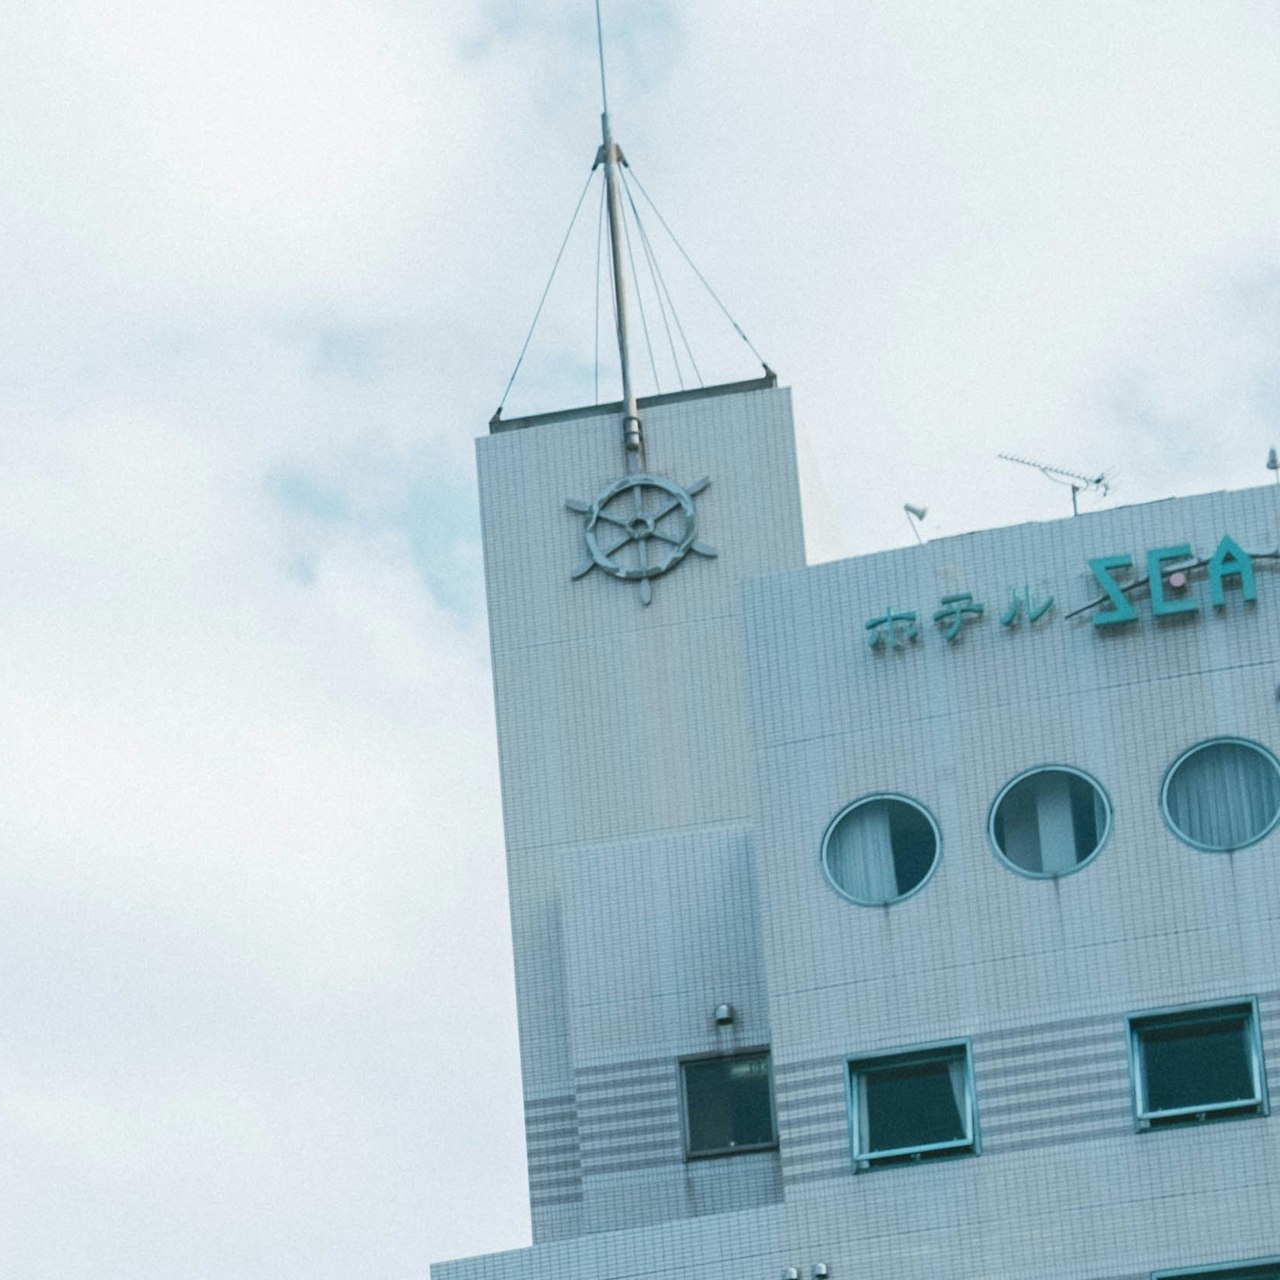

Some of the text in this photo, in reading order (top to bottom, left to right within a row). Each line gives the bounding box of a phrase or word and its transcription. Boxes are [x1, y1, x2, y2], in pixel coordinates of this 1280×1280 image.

[865, 533, 1258, 649] ホテル SEA
